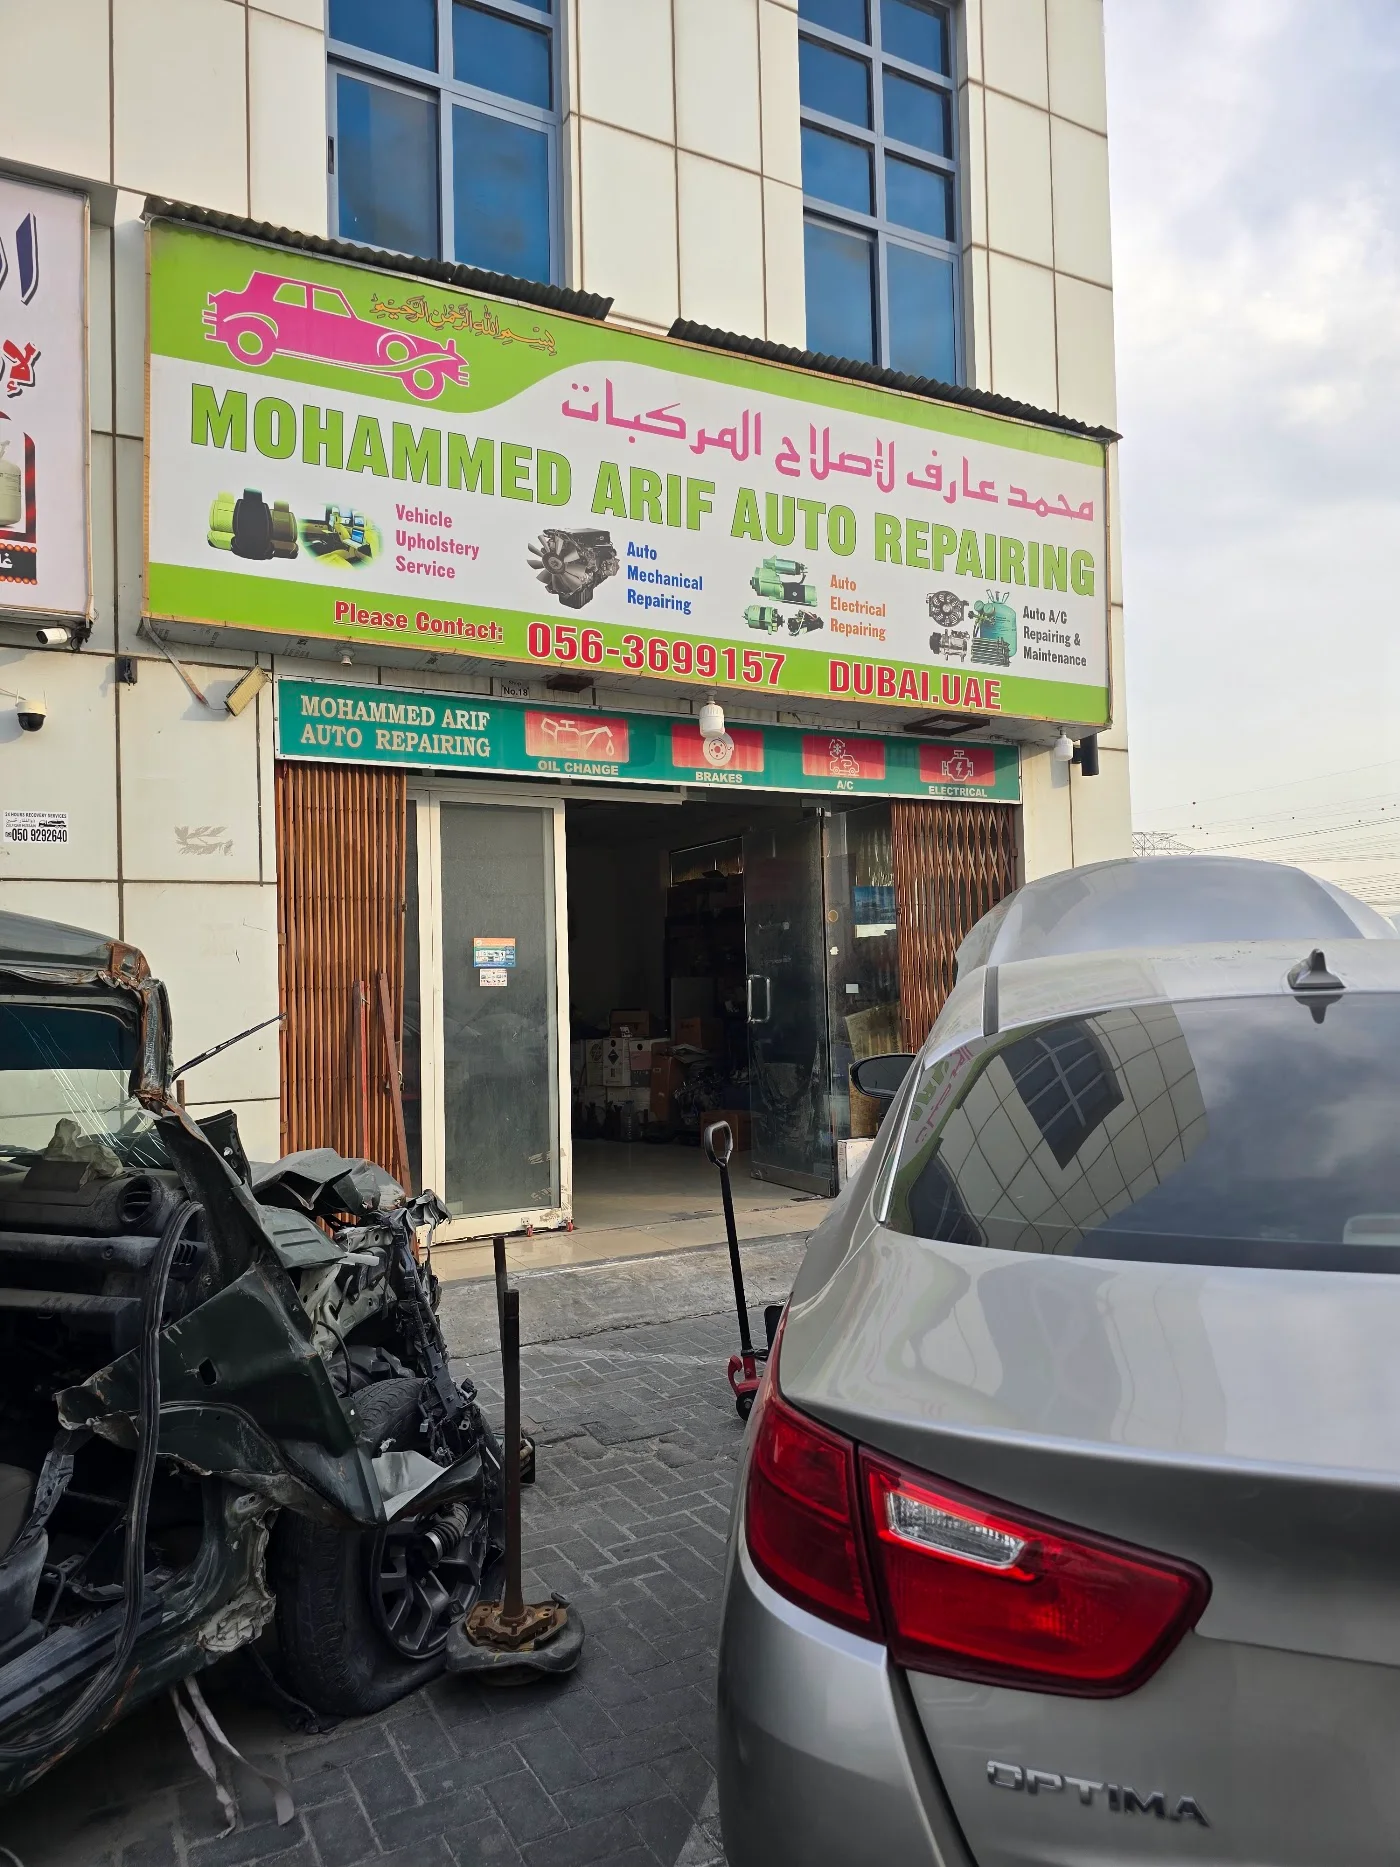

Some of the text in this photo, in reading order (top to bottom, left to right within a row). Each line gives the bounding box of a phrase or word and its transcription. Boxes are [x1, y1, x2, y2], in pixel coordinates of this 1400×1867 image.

[562, 377, 762, 461] المركبات
[906, 450, 998, 504] عارف
[191, 383, 1095, 597] MOHAMMED ARIF AUTO REPAIRING
[1008, 484, 1094, 522] محمد
[395, 504, 453, 529] Vehicle
[395, 530, 480, 561] Upholstery
[627, 541, 658, 562] Auto
[395, 555, 456, 580] Service
[627, 566, 703, 591] Mechanical
[830, 574, 857, 592] Auto
[627, 590, 692, 616] Repairing
[830, 595, 887, 618] Electrical
[1023, 606, 1068, 625] Auto A/C
[334, 601, 504, 642] Please Contact:
[830, 618, 887, 642] Repairing
[1023, 626, 1081, 648] Repairing &
[527, 621, 1001, 711] 056-3699157 DUBAI.UAE
[1023, 645, 1087, 667] Maintenance
[503, 686, 528, 696] No.18
[300, 694, 490, 731] MOHAMMED ARIF
[300, 723, 491, 758] AUTO REPAIRING
[537, 759, 619, 776] OIL CHANGE
[695, 771, 743, 784] BRAKES
[836, 779, 854, 791] A/C
[928, 785, 988, 798] ELECTRICAL
[12, 828, 28, 841] 050
[31, 828, 68, 842] 9292640
[986, 1759, 1211, 1829] OPTIMA
